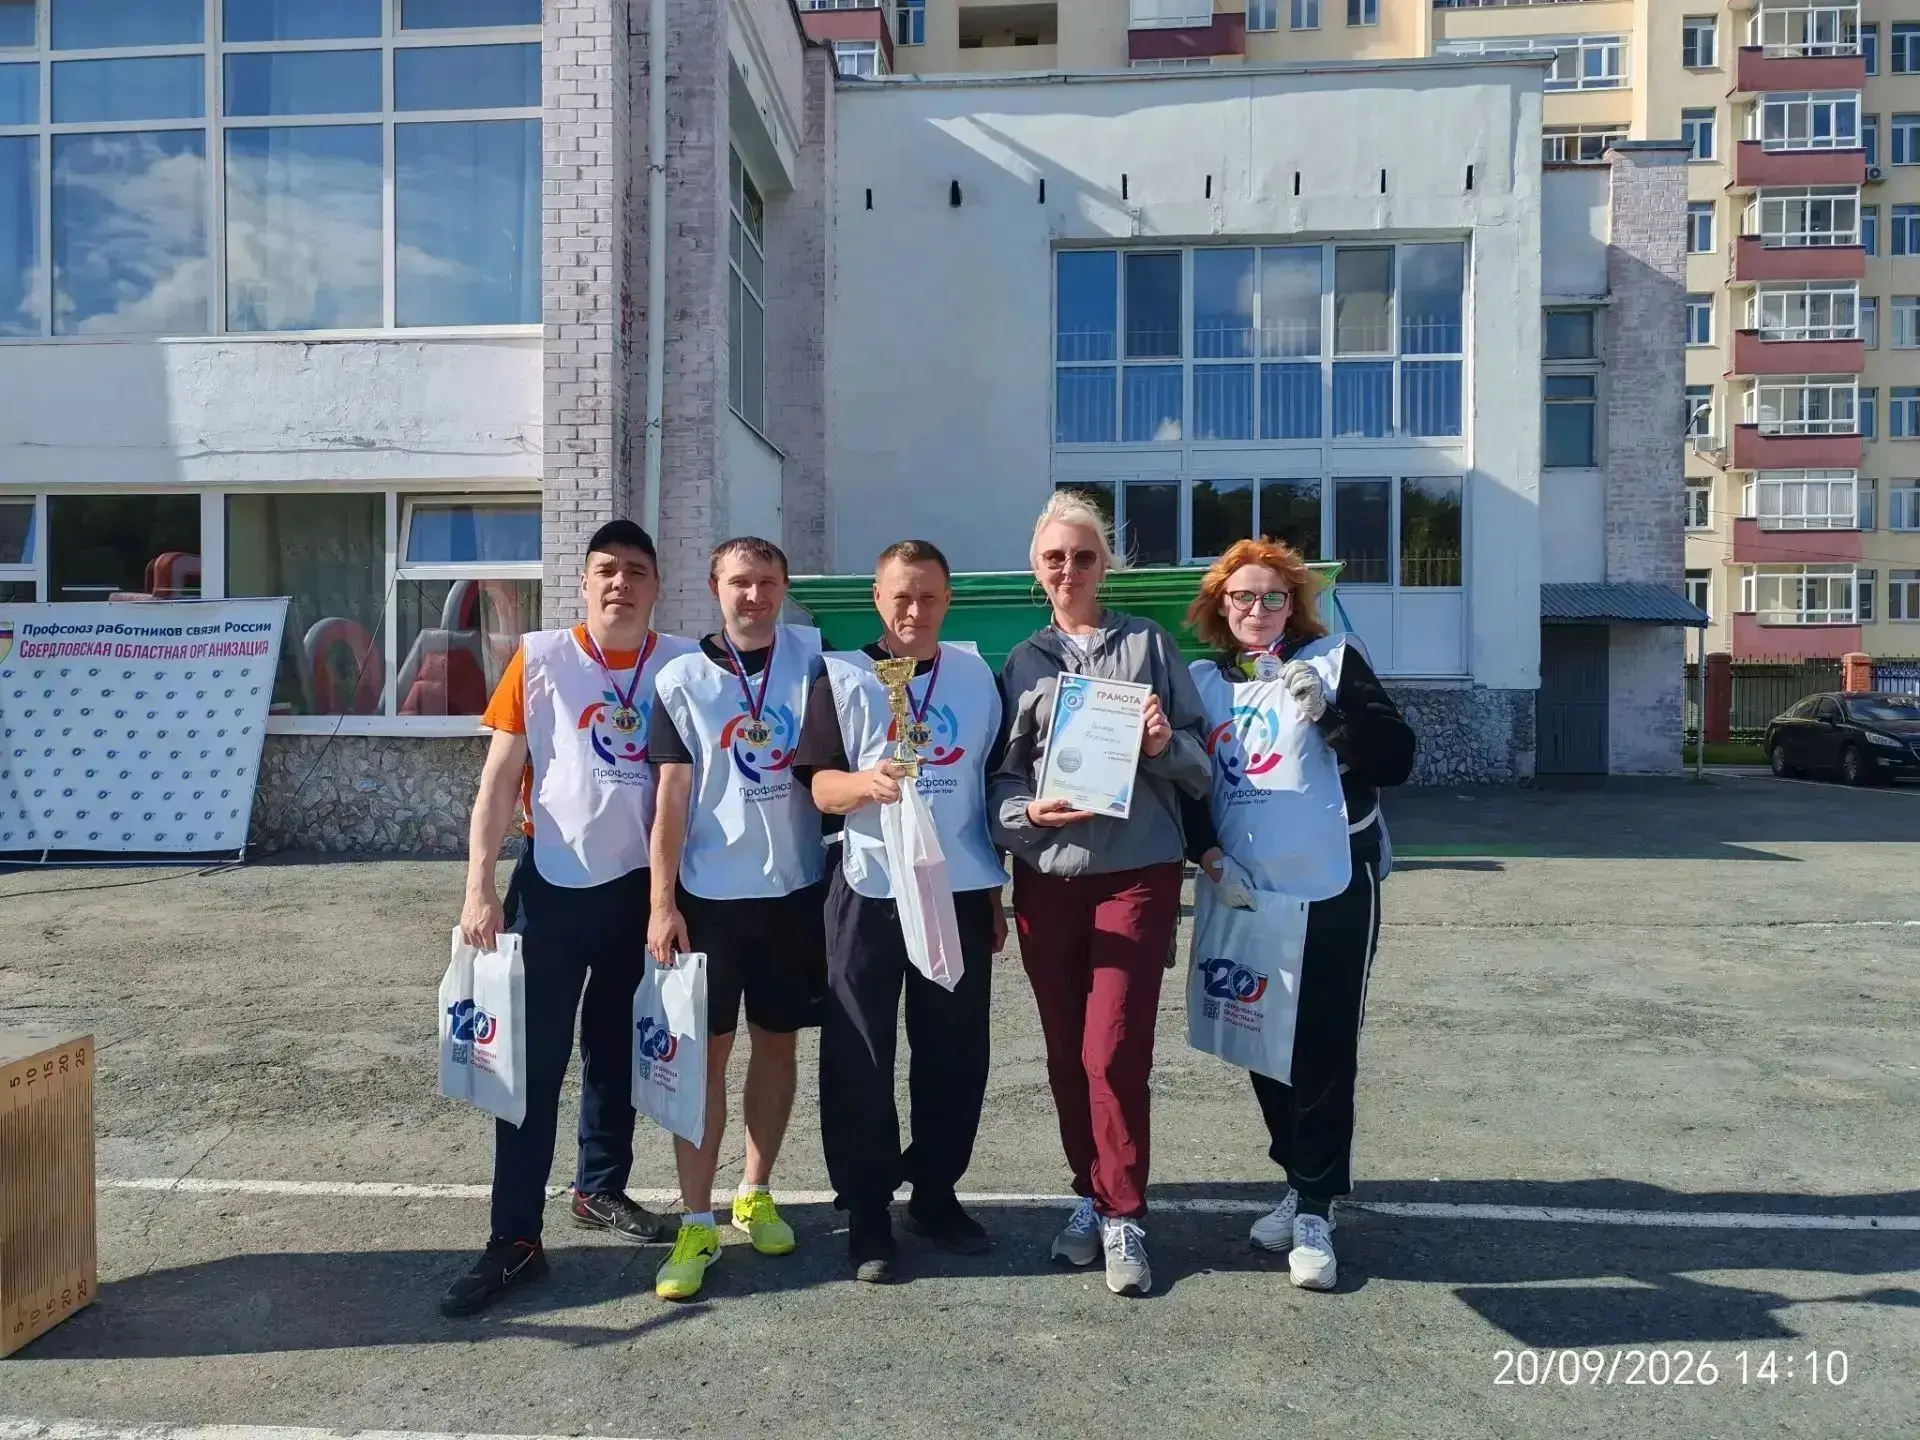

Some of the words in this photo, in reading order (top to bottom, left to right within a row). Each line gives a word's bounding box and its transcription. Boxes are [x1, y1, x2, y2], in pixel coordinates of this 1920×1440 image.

[22, 622, 93, 637] Профсоюз
[95, 623, 183, 637] работников
[186, 624, 221, 636] связи
[224, 621, 272, 633] России
[20, 640, 112, 659] СВЕРДЛОВСКАЯ
[115, 643, 187, 660] ОБЛАСТНАЯ
[190, 640, 269, 659] ОРГАНИЗАЦИЯ
[1096, 690, 1141, 704] ГРАМОТА
[592, 768, 648, 780] Профсоюз
[915, 777, 957, 789] офсоюз
[59, 1054, 69, 1074] 20
[76, 1048, 85, 1068] 25
[26, 1068, 37, 1087] 10
[43, 1060, 53, 1080] 15
[10, 1076, 20, 1088] 5
[61, 1288, 71, 1309] 20
[77, 1279, 87, 1300] 25
[30, 1308, 41, 1328] 10
[46, 1298, 56, 1319] 15
[13, 1321, 24, 1334] 5
